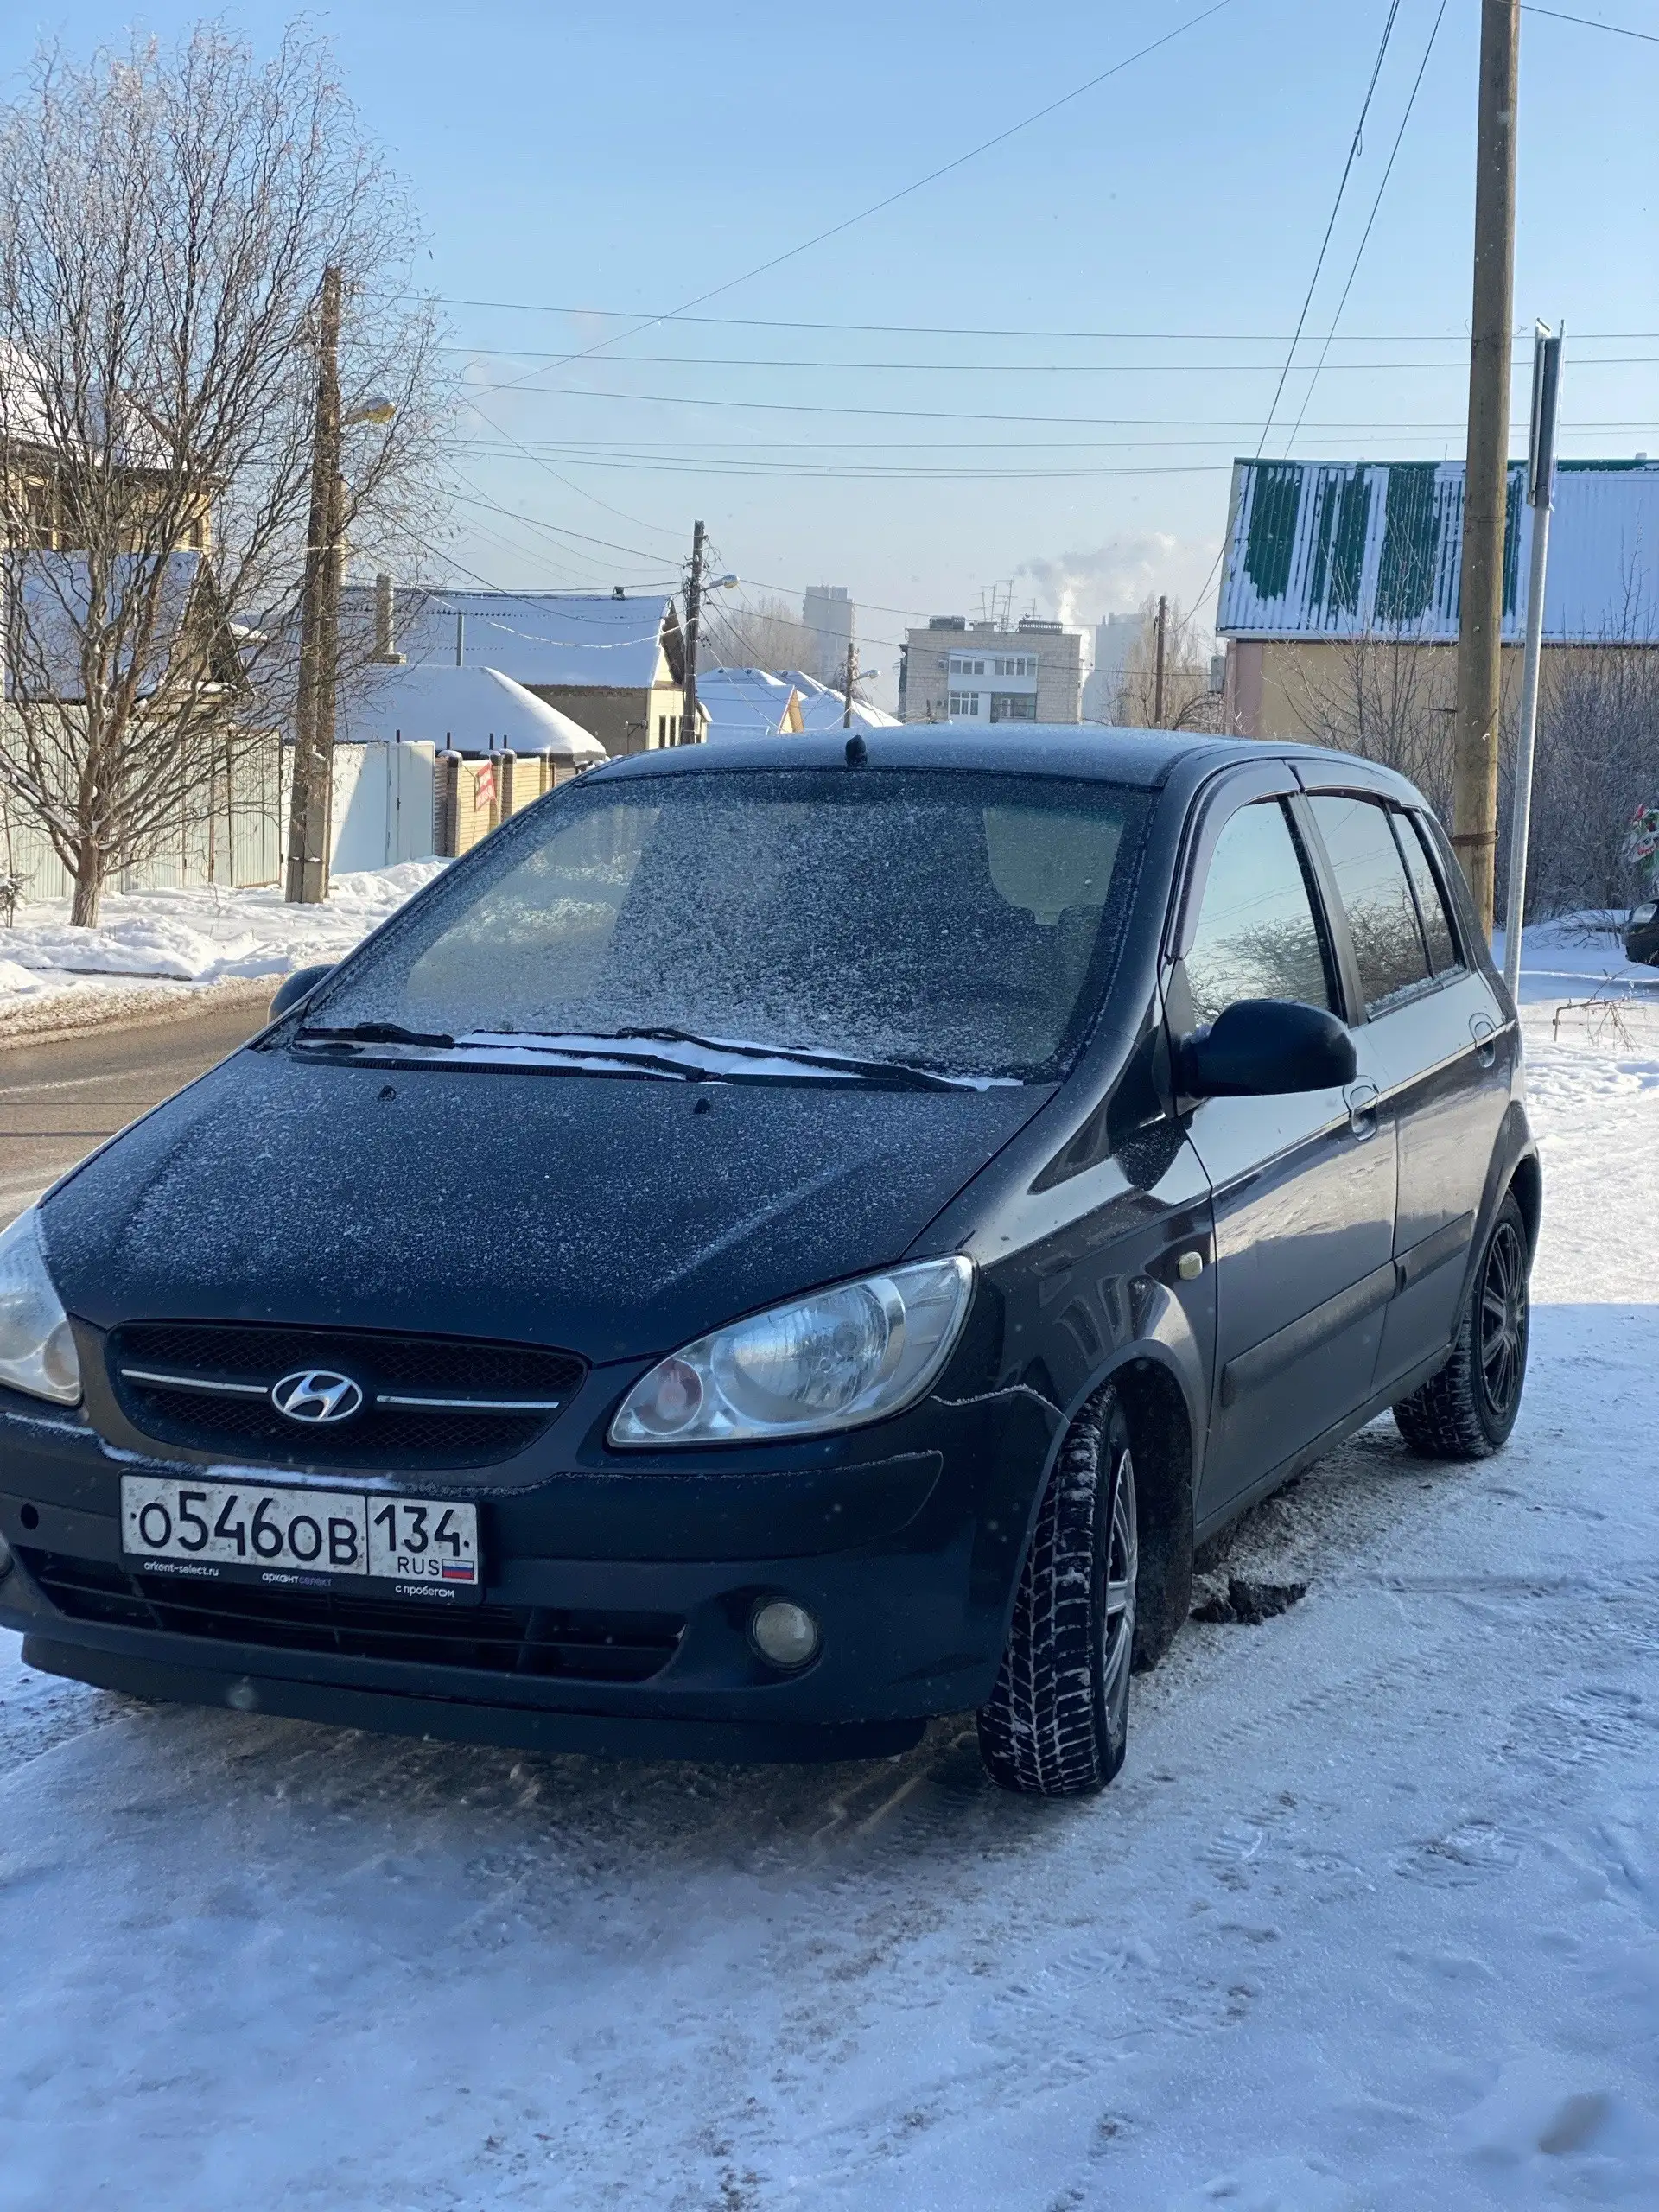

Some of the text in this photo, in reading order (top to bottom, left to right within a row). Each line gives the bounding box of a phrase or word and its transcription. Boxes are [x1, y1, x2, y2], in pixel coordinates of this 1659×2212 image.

[373, 1504, 461, 1556] 134
[143, 1561, 219, 1576] arkont-select.ru
[397, 1556, 440, 1576] RUS
[395, 1585, 454, 1598] с пробегом
